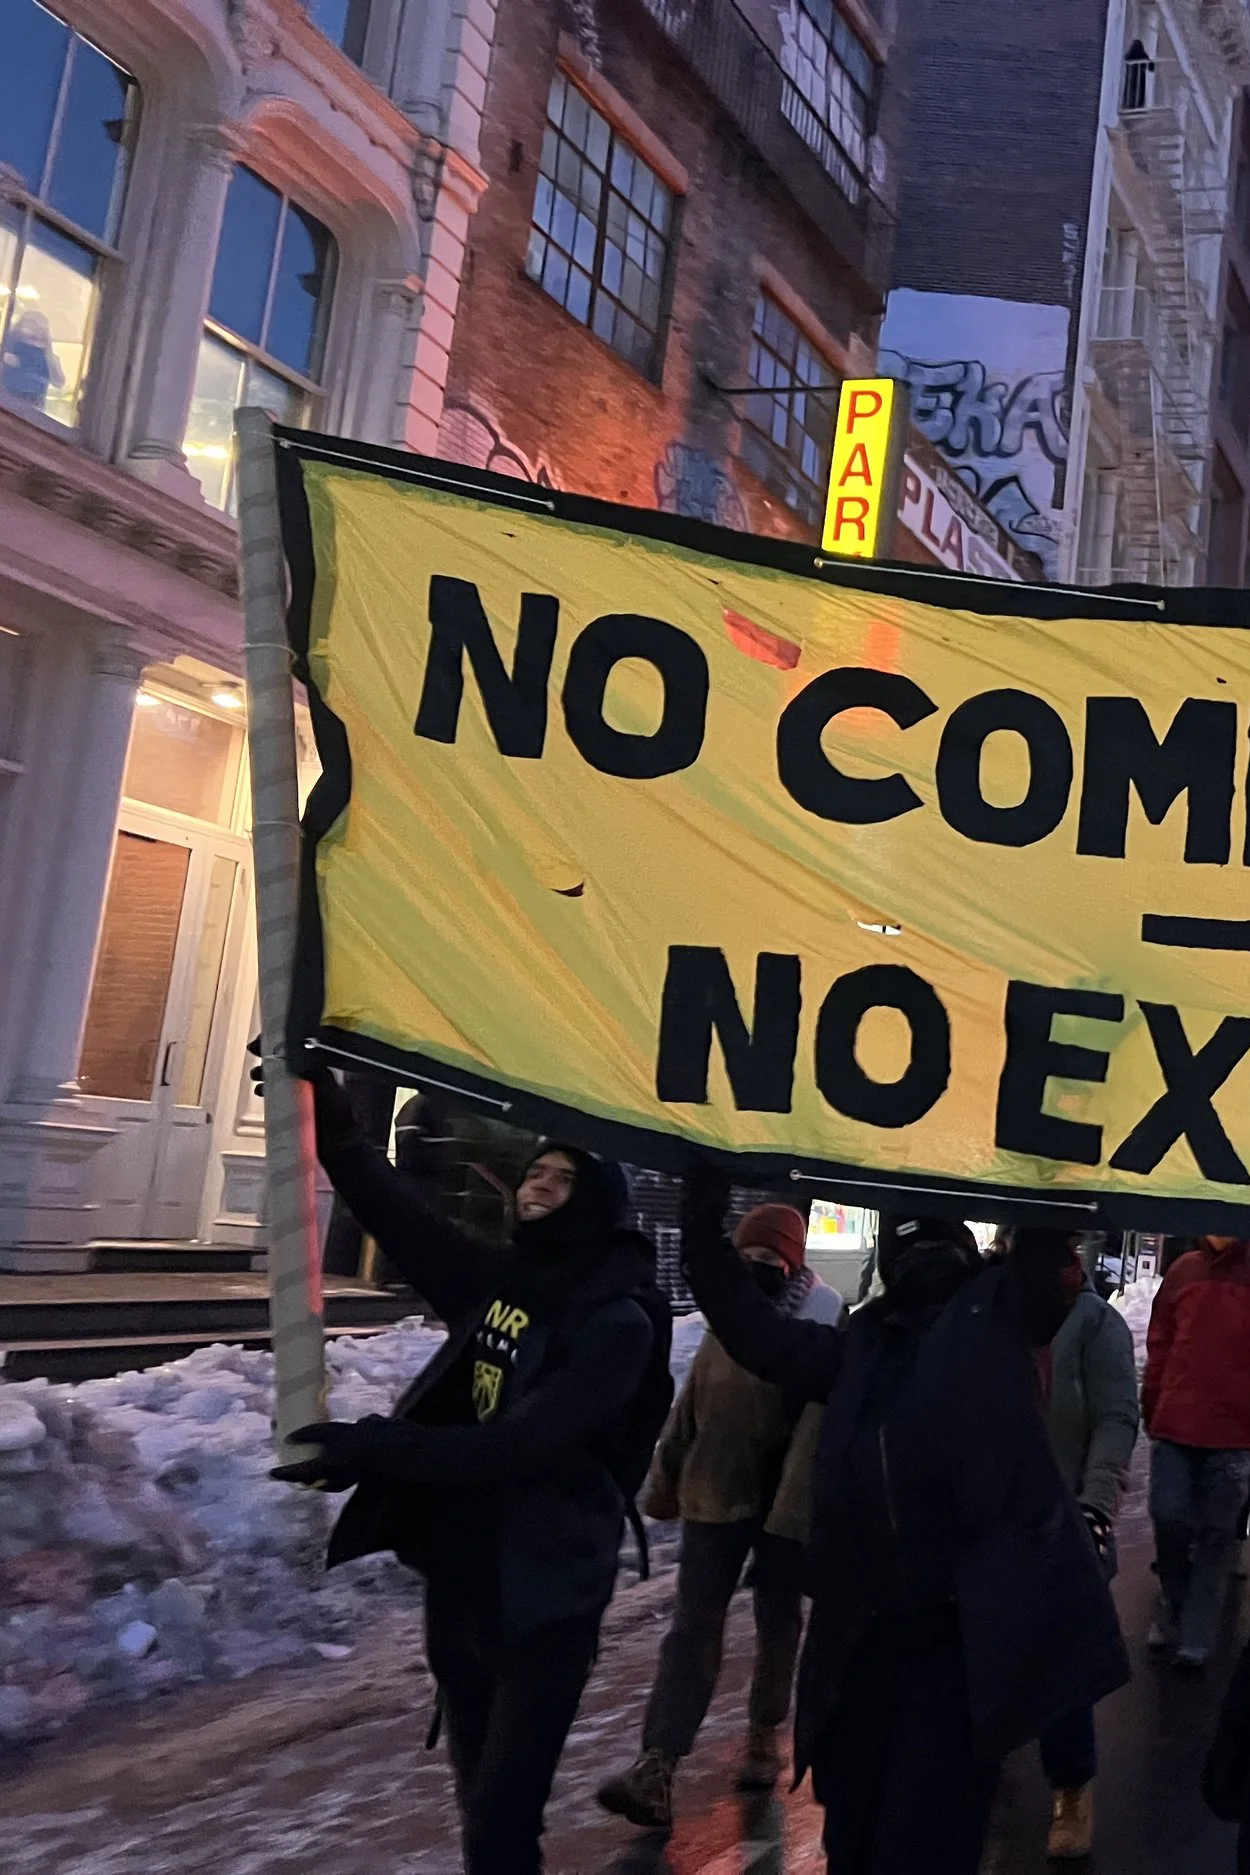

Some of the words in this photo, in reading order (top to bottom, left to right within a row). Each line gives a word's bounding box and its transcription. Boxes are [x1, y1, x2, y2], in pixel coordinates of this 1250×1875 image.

[832, 390, 883, 557] PAR
[414, 574, 710, 779] NO
[656, 945, 952, 1128] NO
